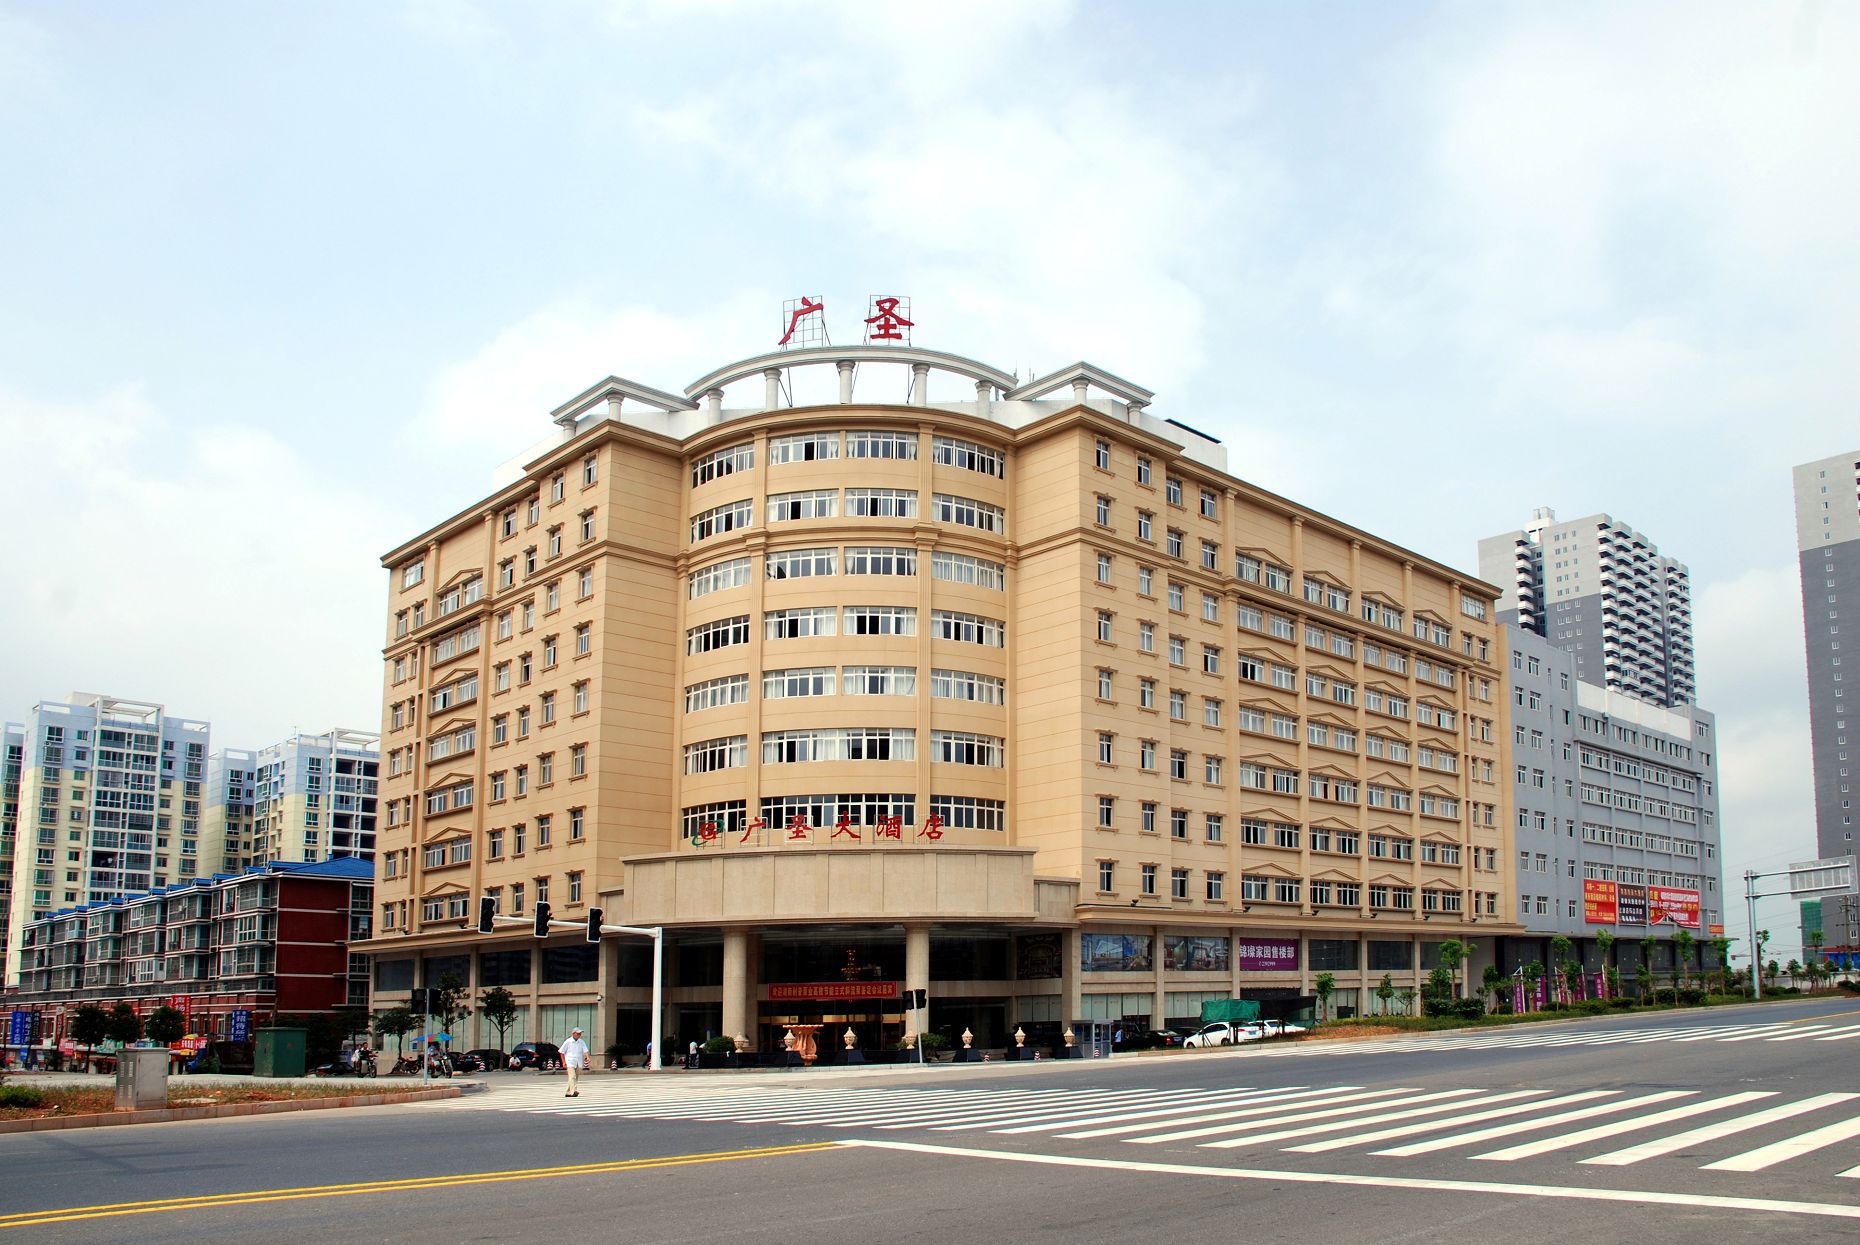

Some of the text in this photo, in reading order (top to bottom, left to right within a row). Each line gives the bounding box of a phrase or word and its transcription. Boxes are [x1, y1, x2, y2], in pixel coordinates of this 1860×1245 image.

[778, 296, 915, 345] 广圣
[740, 810, 946, 844] 广圣大酒店
